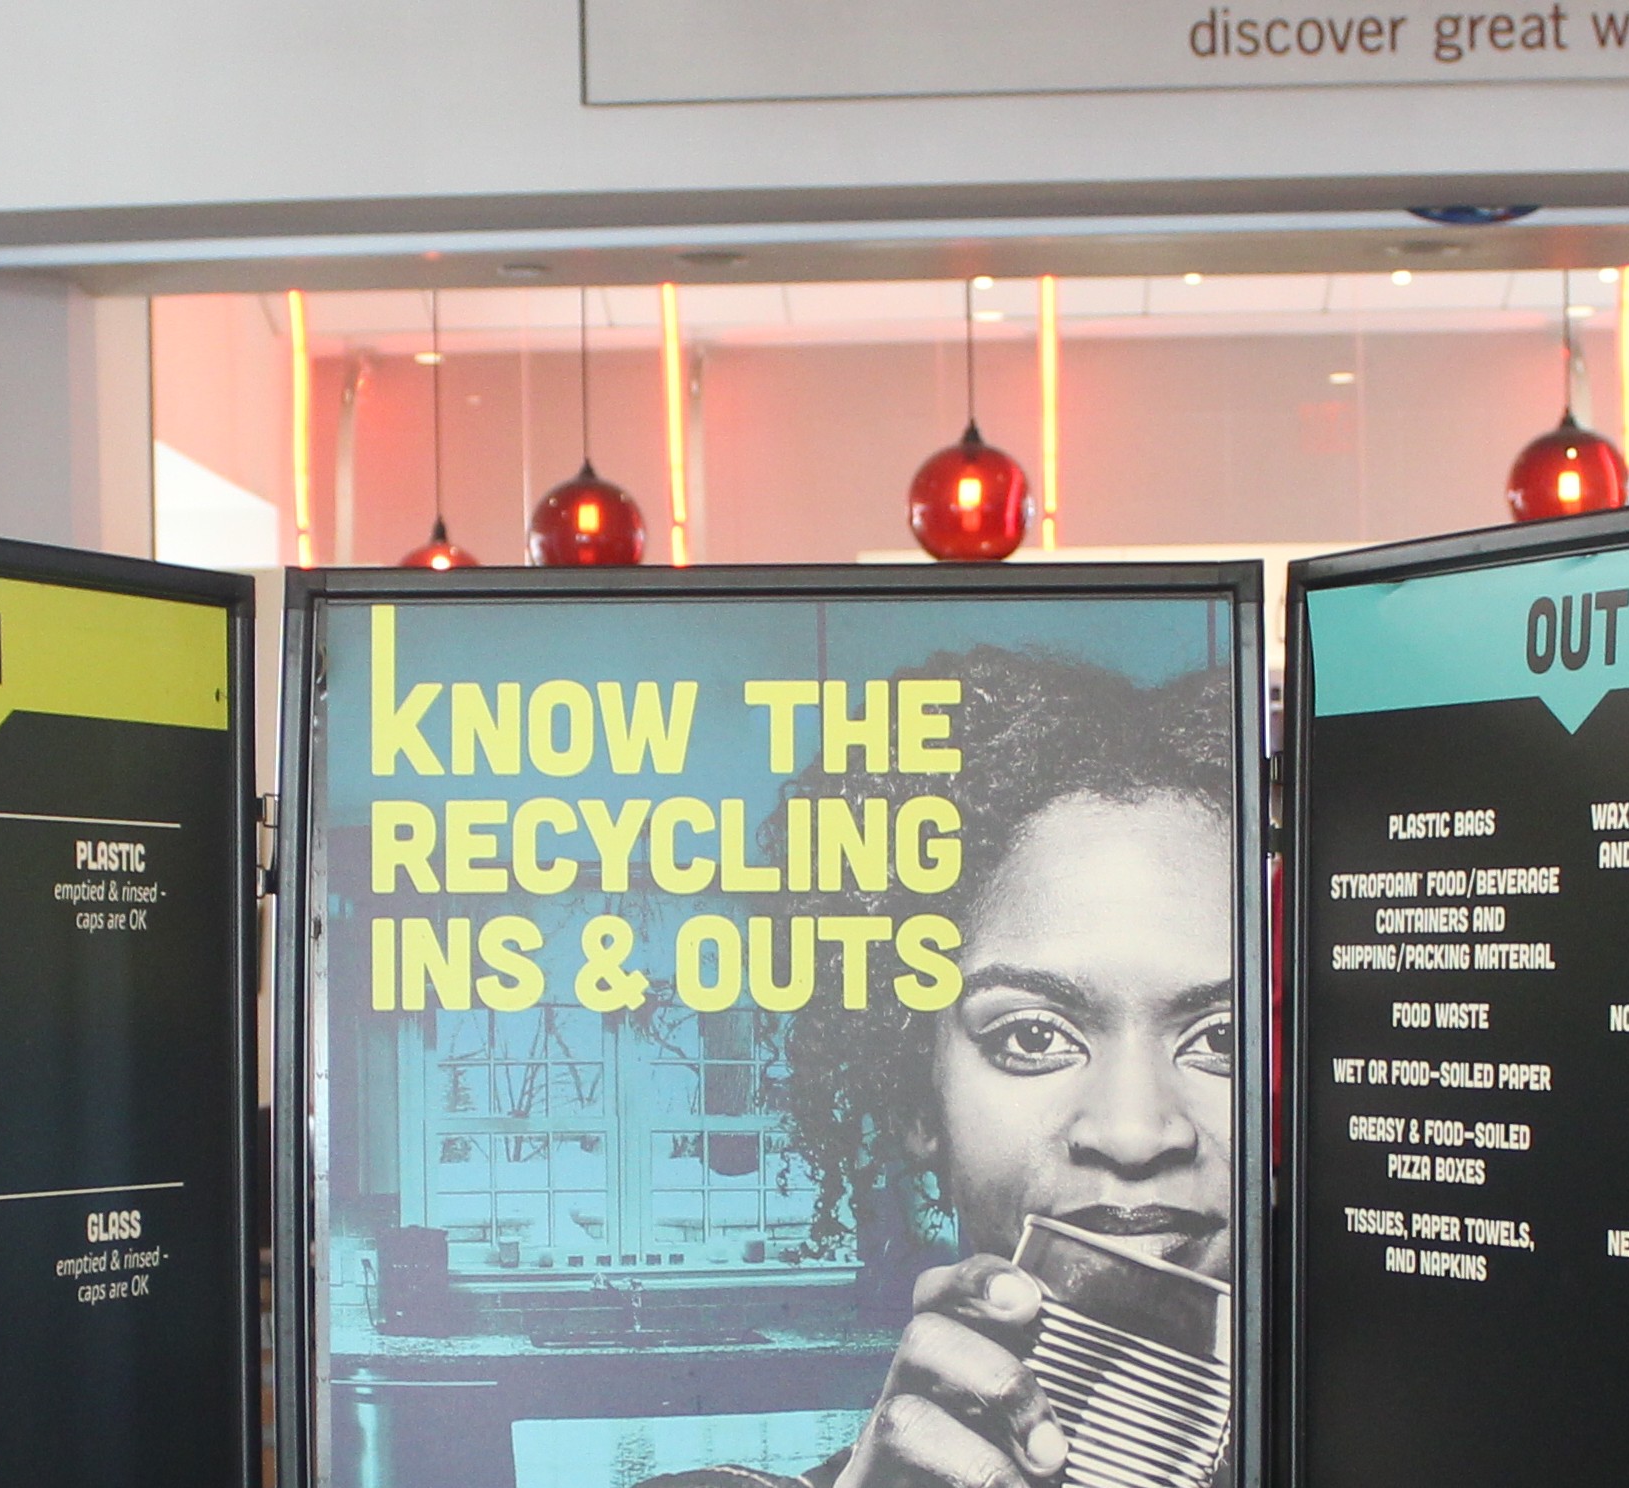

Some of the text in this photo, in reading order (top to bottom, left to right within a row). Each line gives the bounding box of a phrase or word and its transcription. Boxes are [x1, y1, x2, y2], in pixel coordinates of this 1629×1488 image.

[1190, 7, 1407, 57] discover
[1434, 2, 1567, 63] great
[745, 678, 963, 774] THE
[1388, 808, 1496, 840] PLASTIC BAGS
[75, 840, 146, 873] PLASTIC
[372, 795, 963, 894] RECYCLING
[54, 879, 105, 904] emptied
[108, 879, 119, 902] &
[121, 880, 158, 903] rinsed
[1426, 866, 1561, 899] FOOD/BEVERAGE
[76, 908, 147, 934] caps are OK
[1375, 905, 1506, 934] CONTAINERS AND
[372, 913, 964, 1012] INS & OUTS
[1332, 942, 1556, 973] SHIPPING/PACKING MATERIAL
[1392, 1001, 1490, 1029] FOOD WASTE
[1332, 1058, 1552, 1091] WET OR FOOD-SOILED PAPER
[1349, 1115, 1531, 1151] GREASY & FOOD-SOILED
[1388, 1153, 1486, 1185] PIZZA BOXES
[87, 1209, 142, 1243] GLASS
[1344, 1207, 1535, 1252] TISSUES, PAPER TOWELS,
[56, 1250, 108, 1280] emptied
[110, 1249, 121, 1271] &
[123, 1245, 160, 1270] rinsed
[1385, 1246, 1487, 1282] AND NAPKINS
[77, 1274, 150, 1306] caps are OK
